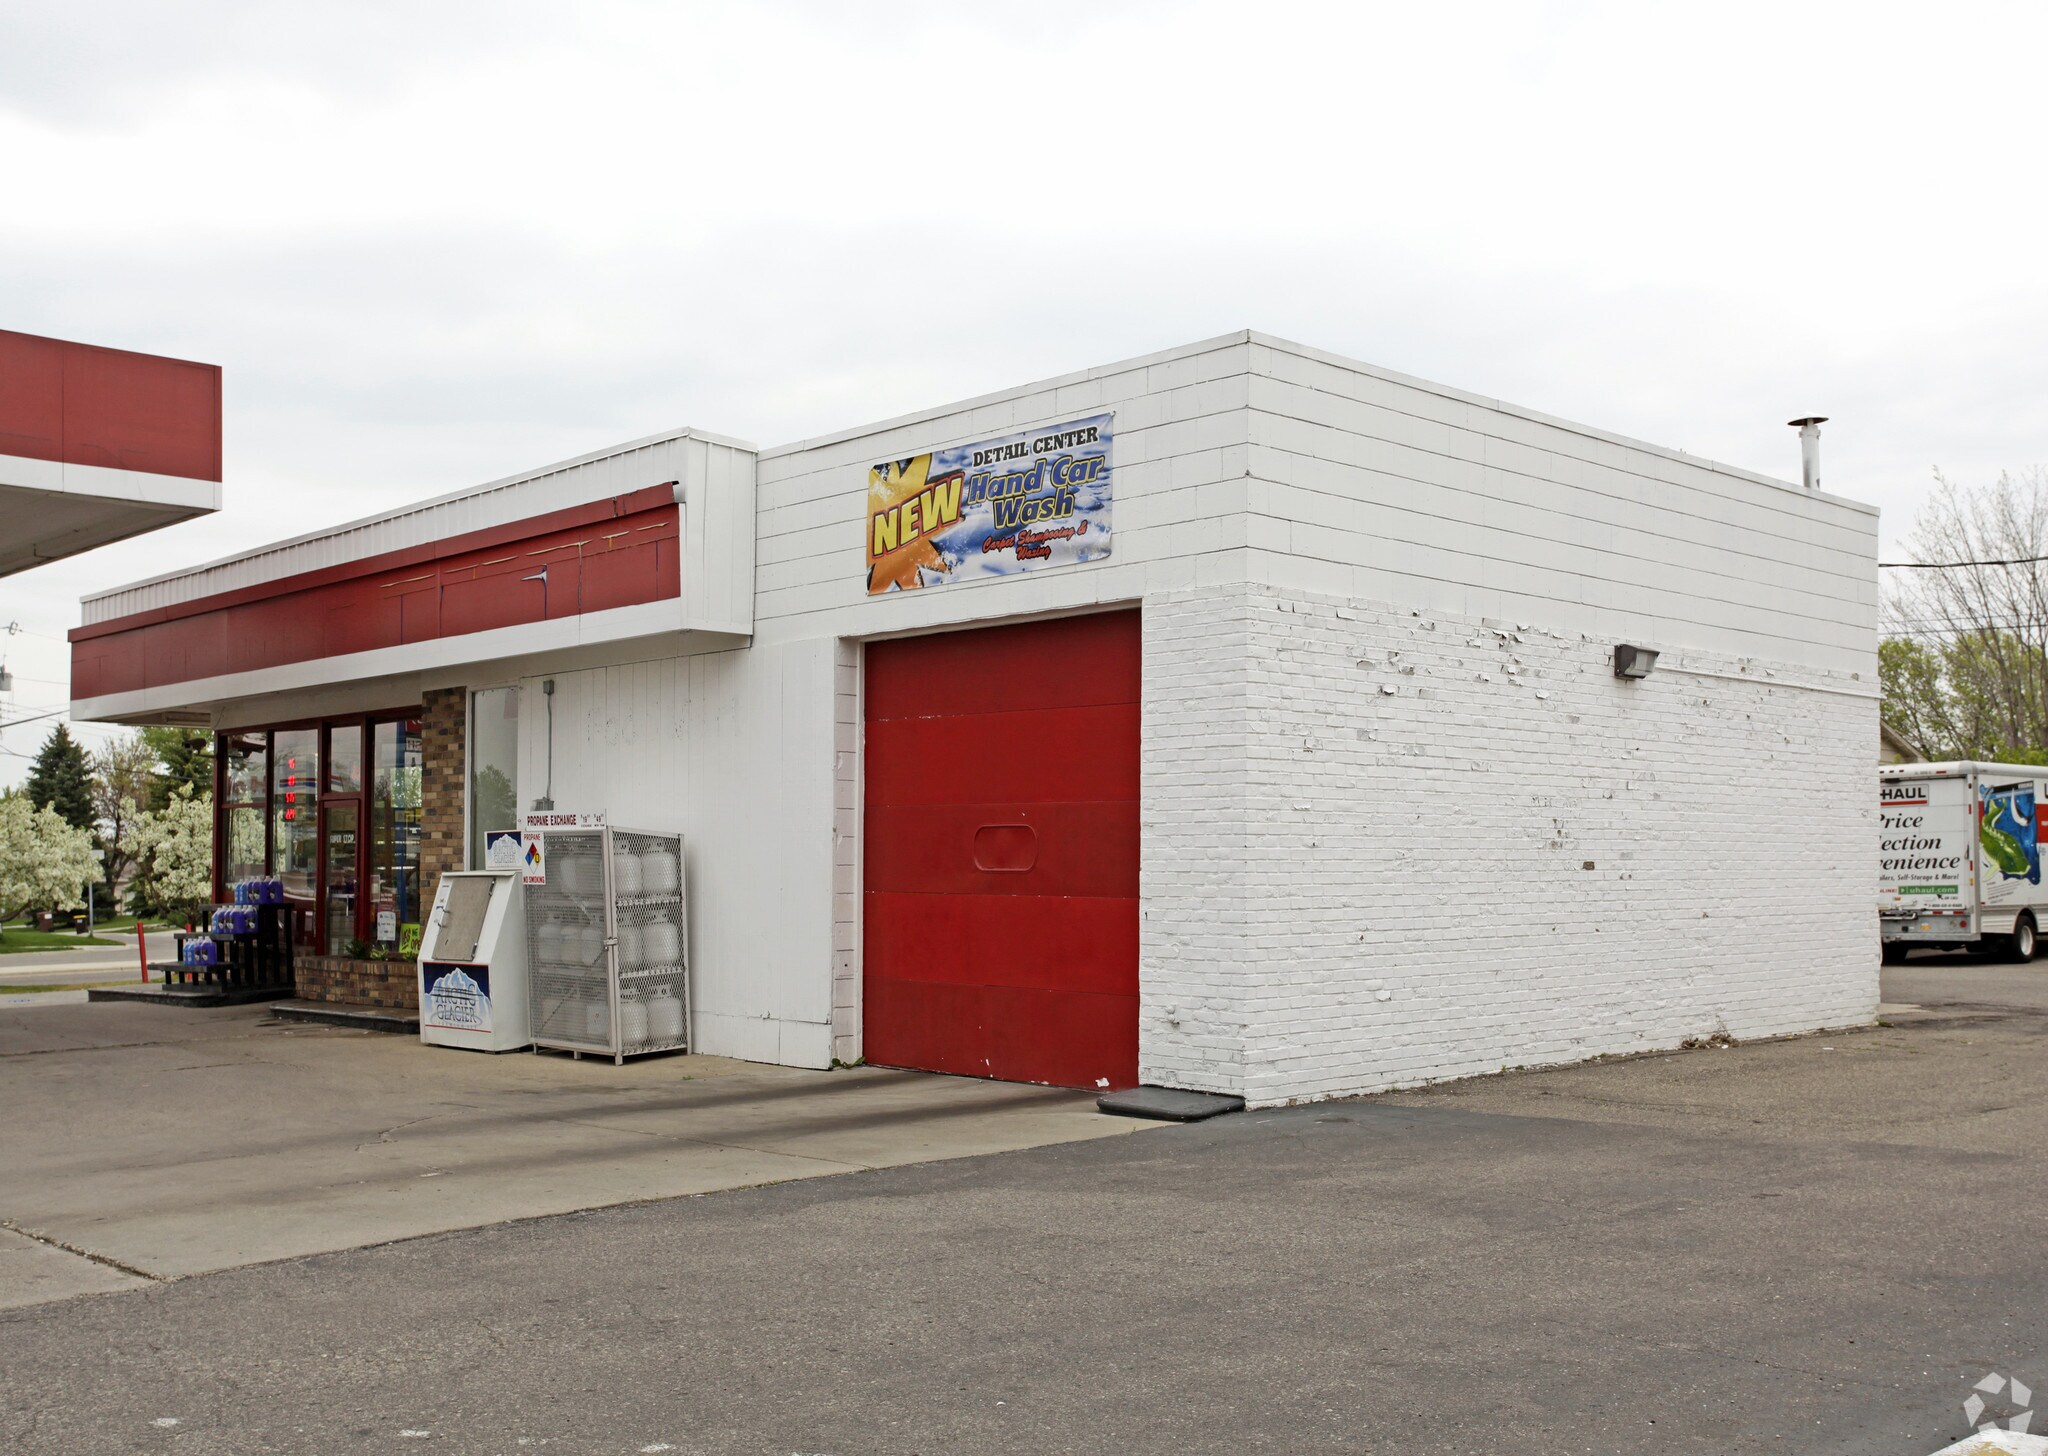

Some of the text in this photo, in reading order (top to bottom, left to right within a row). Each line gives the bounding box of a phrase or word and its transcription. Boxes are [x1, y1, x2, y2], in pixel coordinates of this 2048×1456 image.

[973, 427, 1098, 467] DETAIL CENTER
[968, 456, 1105, 504] Hand Car
[871, 474, 964, 557] NEW
[993, 486, 1075, 529] Wash
[982, 519, 1088, 553] Carpet Shampooing &
[1016, 545, 1051, 560] Waxing
[527, 814, 576, 826] PROPANE EXCHANGE
[523, 833, 541, 841] PROPANE
[1880, 835, 1941, 851] ection
[1880, 854, 1960, 870] enience
[523, 876, 544, 884] NO SMOKING
[1898, 874, 1933, 882] Self-Storage
[1909, 886, 1955, 894] uhaul.com
[435, 984, 476, 1006] ARCTIC
[437, 1004, 477, 1023] GLACIER
